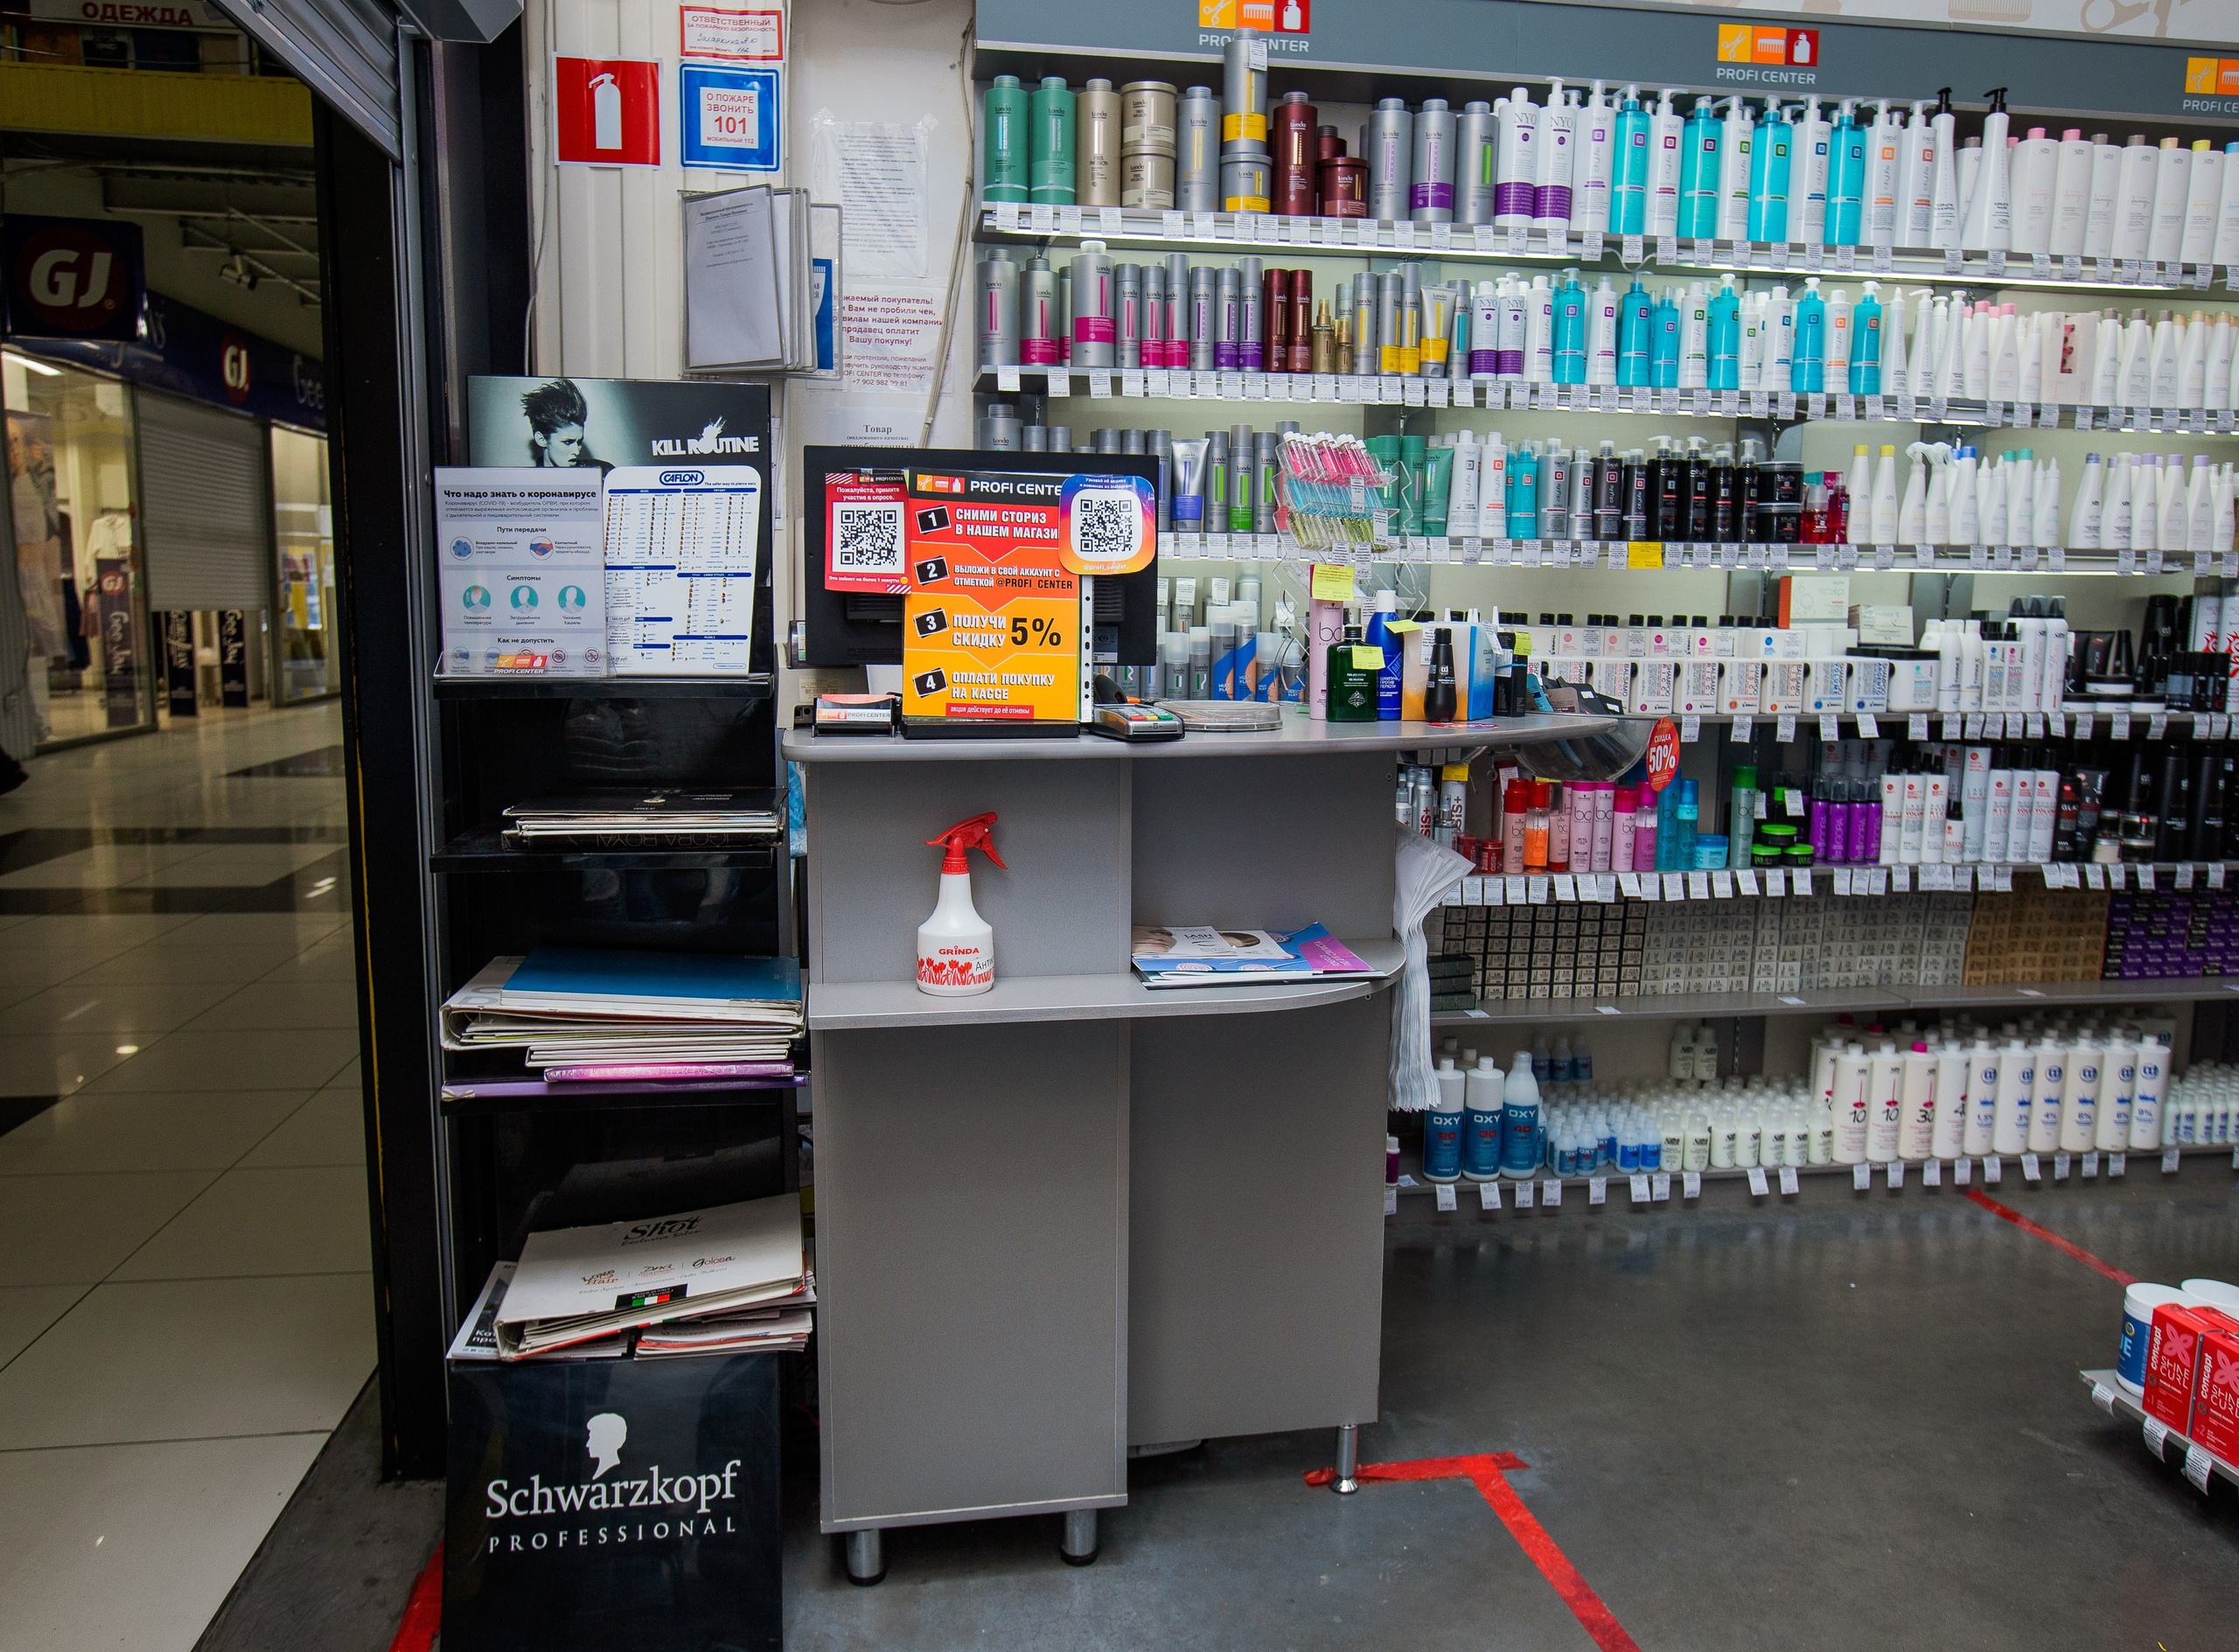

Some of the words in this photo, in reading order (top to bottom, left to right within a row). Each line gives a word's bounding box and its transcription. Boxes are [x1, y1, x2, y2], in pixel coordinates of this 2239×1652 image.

[82, 3, 194, 26] ОДЕЖДА
[692, 15, 771, 26] ОТВЕТСТВЕННЫЙ
[1716, 67, 1758, 81] PROFI
[1761, 70, 1816, 85] CENTER
[715, 94, 754, 104] ПОЖАРЕ
[2183, 99, 2221, 112] PROFI
[706, 103, 754, 115] ЗВОНИТЬ
[715, 115, 747, 135] 101
[30, 249, 112, 308] GJ
[882, 296, 933, 305] покупатель!
[880, 306, 917, 315] пробили
[841, 325, 883, 334] продавец
[849, 336, 873, 345] Вашу
[875, 338, 912, 347] покупку!
[224, 345, 247, 390] GJ
[863, 424, 892, 436] Товар
[652, 439, 687, 456] KILL
[664, 473, 699, 483] CAFLON
[464, 491, 488, 499] надо
[527, 491, 596, 500] коронавирусе
[971, 481, 1013, 494] PROFI
[1017, 483, 1062, 496] CENTE
[928, 512, 938, 527] 1
[955, 508, 998, 522] СНИМИ
[1001, 510, 1047, 524] СТОРИЗ
[955, 523, 963, 535] В
[966, 525, 1009, 538] НАШЕМ
[926, 562, 938, 579] 2
[954, 564, 989, 575] ВЫЛОЖИ
[998, 565, 1017, 576] СВОЙ
[1019, 568, 1053, 577] АККАУНТ
[1054, 568, 1060, 577] С
[953, 577, 994, 588] ОТМЕТКОЙ
[995, 578, 1073, 590] @PROFI_CENTER
[925, 615, 937, 631] 3
[952, 614, 1007, 630] ПОЛУЧИ
[1011, 617, 1062, 646] 5%
[952, 632, 1007, 648] СКИДКУ
[925, 675, 937, 690] 4
[952, 672, 998, 685] ОПЛАТИ
[1001, 673, 1055, 687] ПОКУПКУ
[952, 687, 967, 699] НА
[971, 688, 1009, 701] КАССЕ
[967, 706, 994, 714] действует
[1654, 732, 1671, 743] СКИДКА
[1649, 743, 1676, 774] 50%
[938, 945, 980, 955] GRINDA
[1433, 1116, 1461, 1126] OXY
[1474, 1114, 1500, 1124] OXY
[1509, 1109, 1536, 1119] OXY
[1850, 1109, 1866, 1124] 10
[1882, 1109, 1899, 1123] 10
[1479, 1130, 1496, 1139] 30
[1513, 1126, 1532, 1134] 40
[624, 1216, 703, 1241] Shot
[2151, 1325, 2162, 1371] concept
[2201, 1353, 2213, 1399] concept
[485, 1460, 741, 1519] Schwarzkopf
[489, 1516, 736, 1554] PROFESSIONAL
